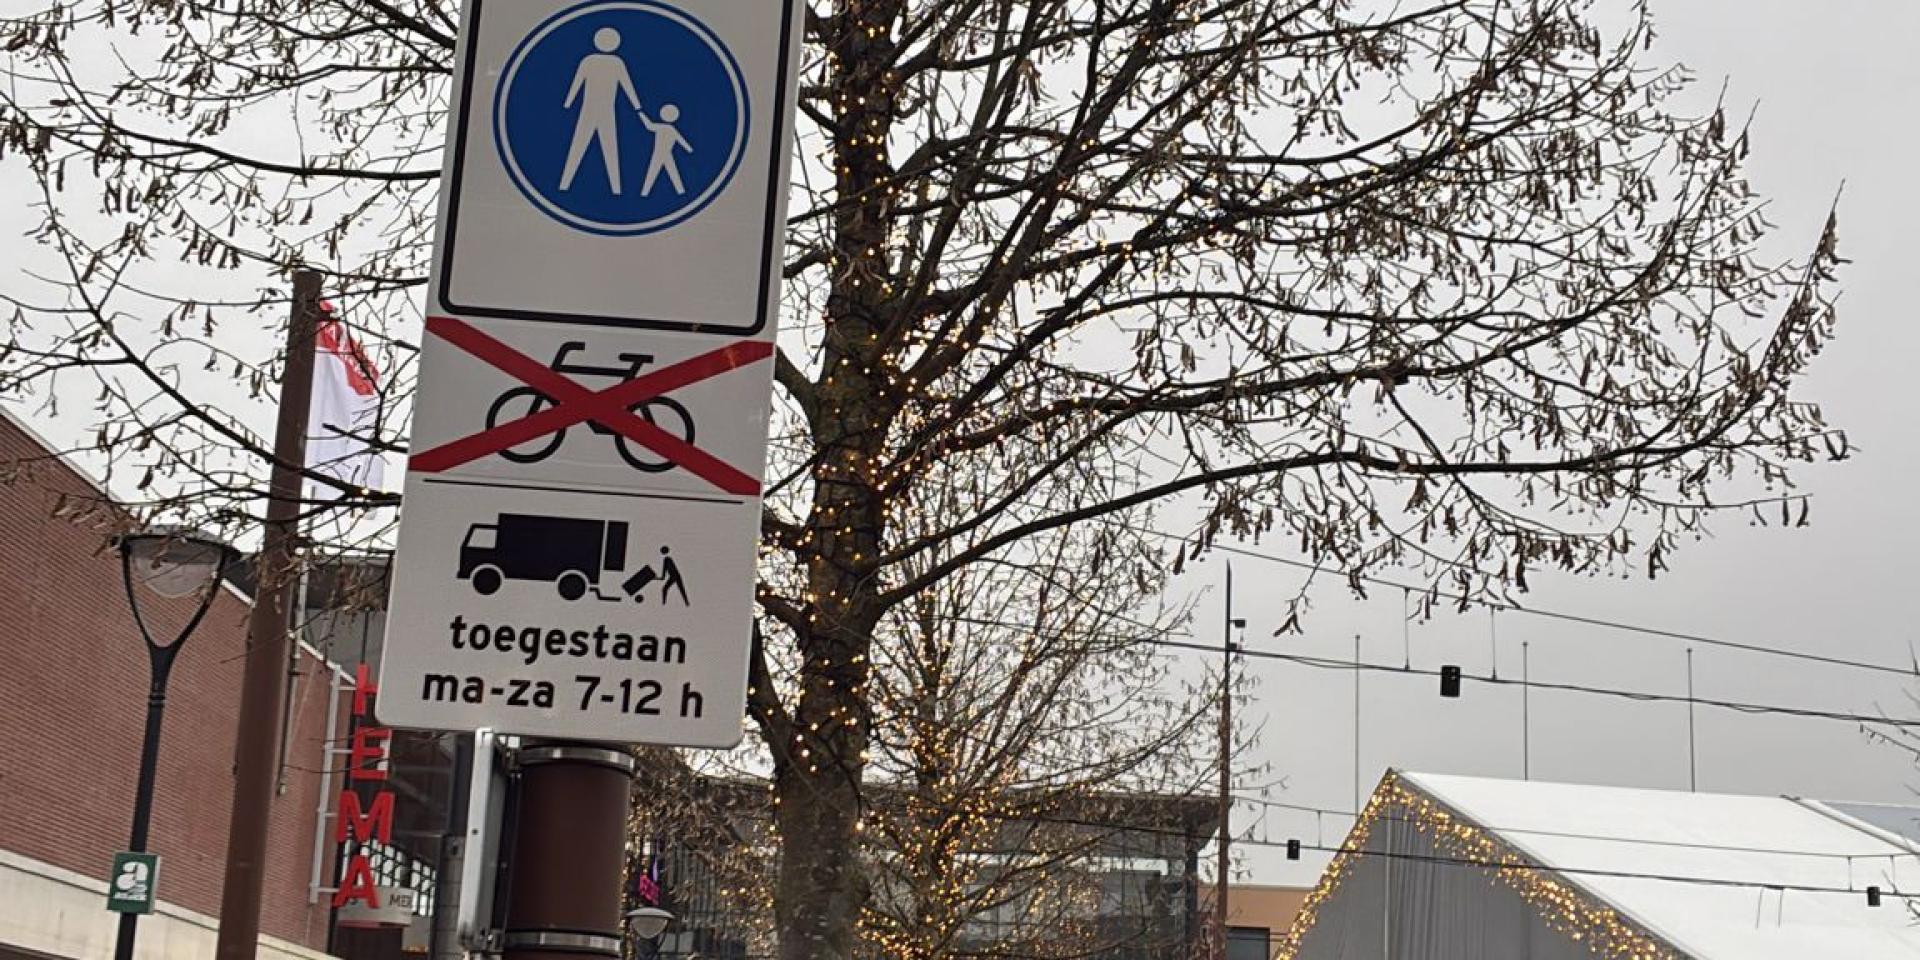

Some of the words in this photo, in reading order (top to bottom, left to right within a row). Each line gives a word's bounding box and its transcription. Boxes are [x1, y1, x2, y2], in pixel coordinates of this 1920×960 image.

[449, 614, 686, 666] toegestaan
[421, 673, 556, 709] ma-za
[574, 674, 663, 716] 7-12
[679, 682, 704, 719] h
